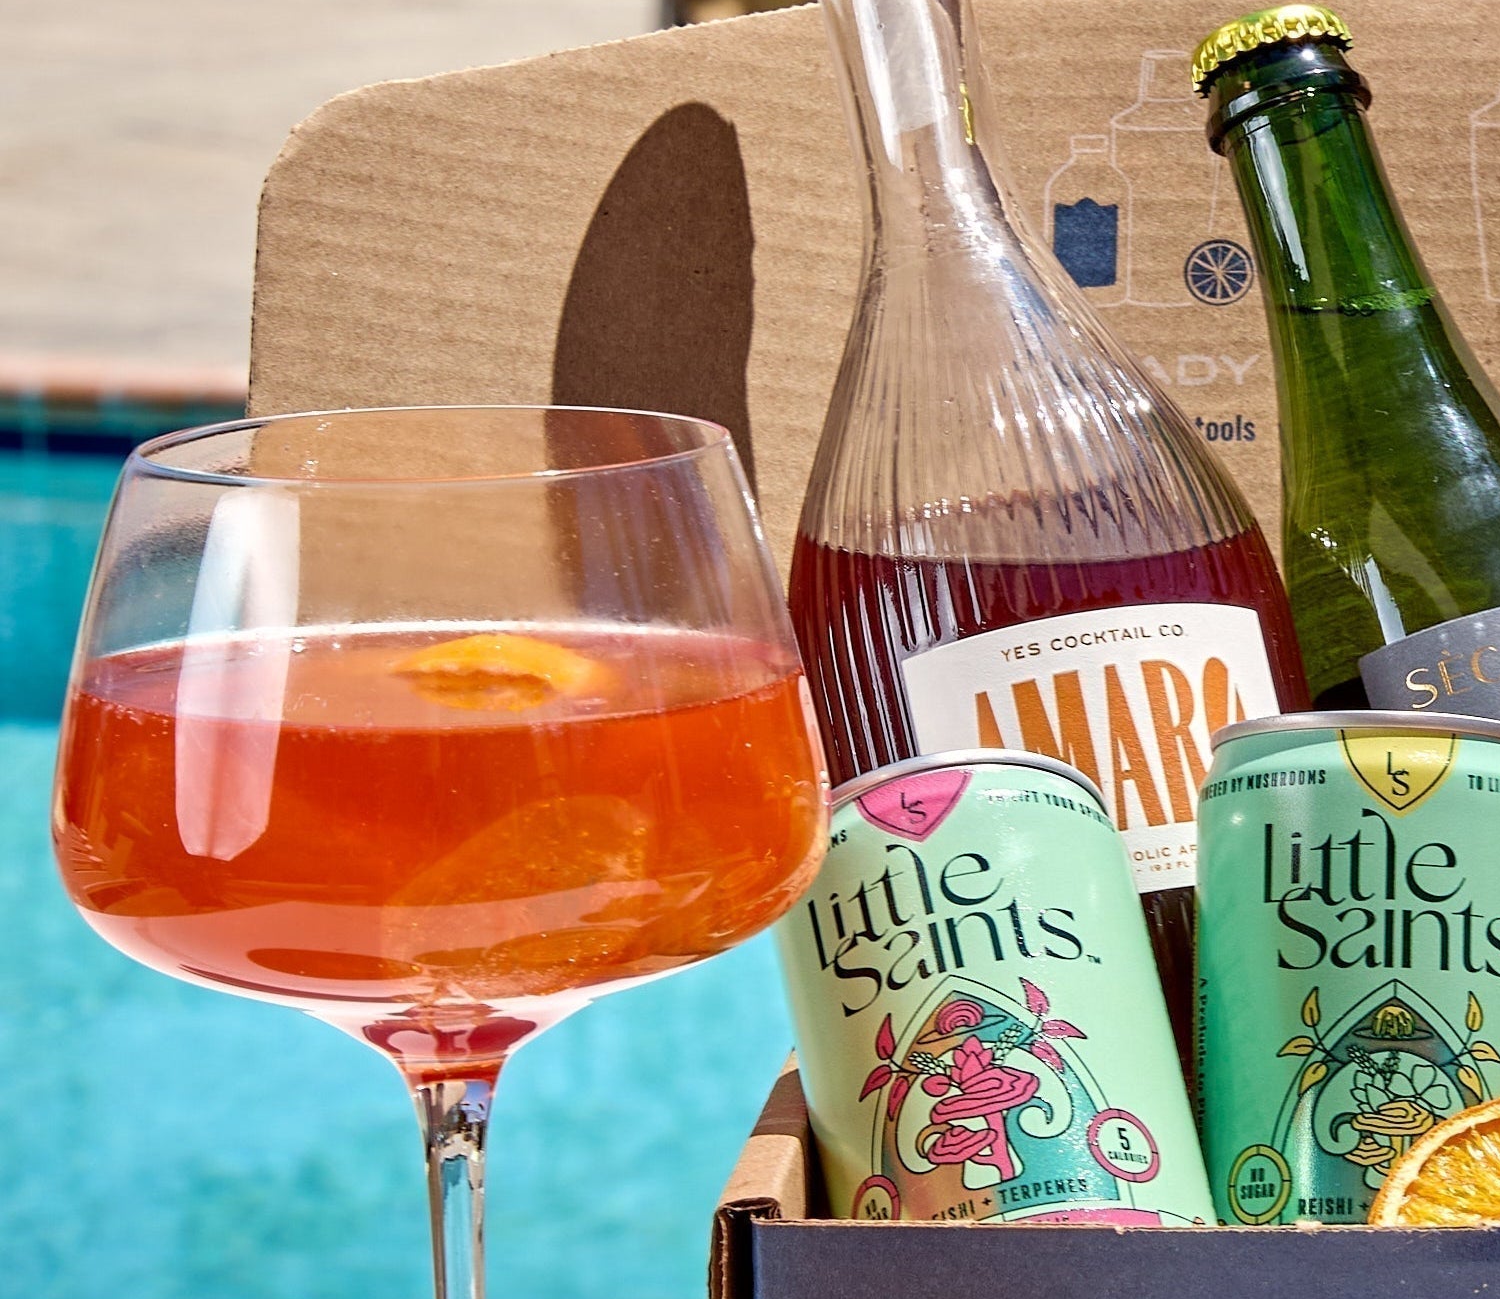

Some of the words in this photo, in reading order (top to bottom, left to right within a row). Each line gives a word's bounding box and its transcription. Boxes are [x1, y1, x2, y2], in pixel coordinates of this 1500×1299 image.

[999, 641, 1042, 663] YES
[1049, 625, 1152, 651] COCKTAIL
[1246, 769, 1327, 790] MUSHROOMS
[1263, 807, 1467, 907] Little
[807, 843, 1005, 971] Little
[1116, 1126, 1131, 1151] 5
[999, 1178, 1088, 1204] TERPENES
[1239, 1182, 1277, 1200] SUGAR
[1298, 1197, 1353, 1216] REISHI
